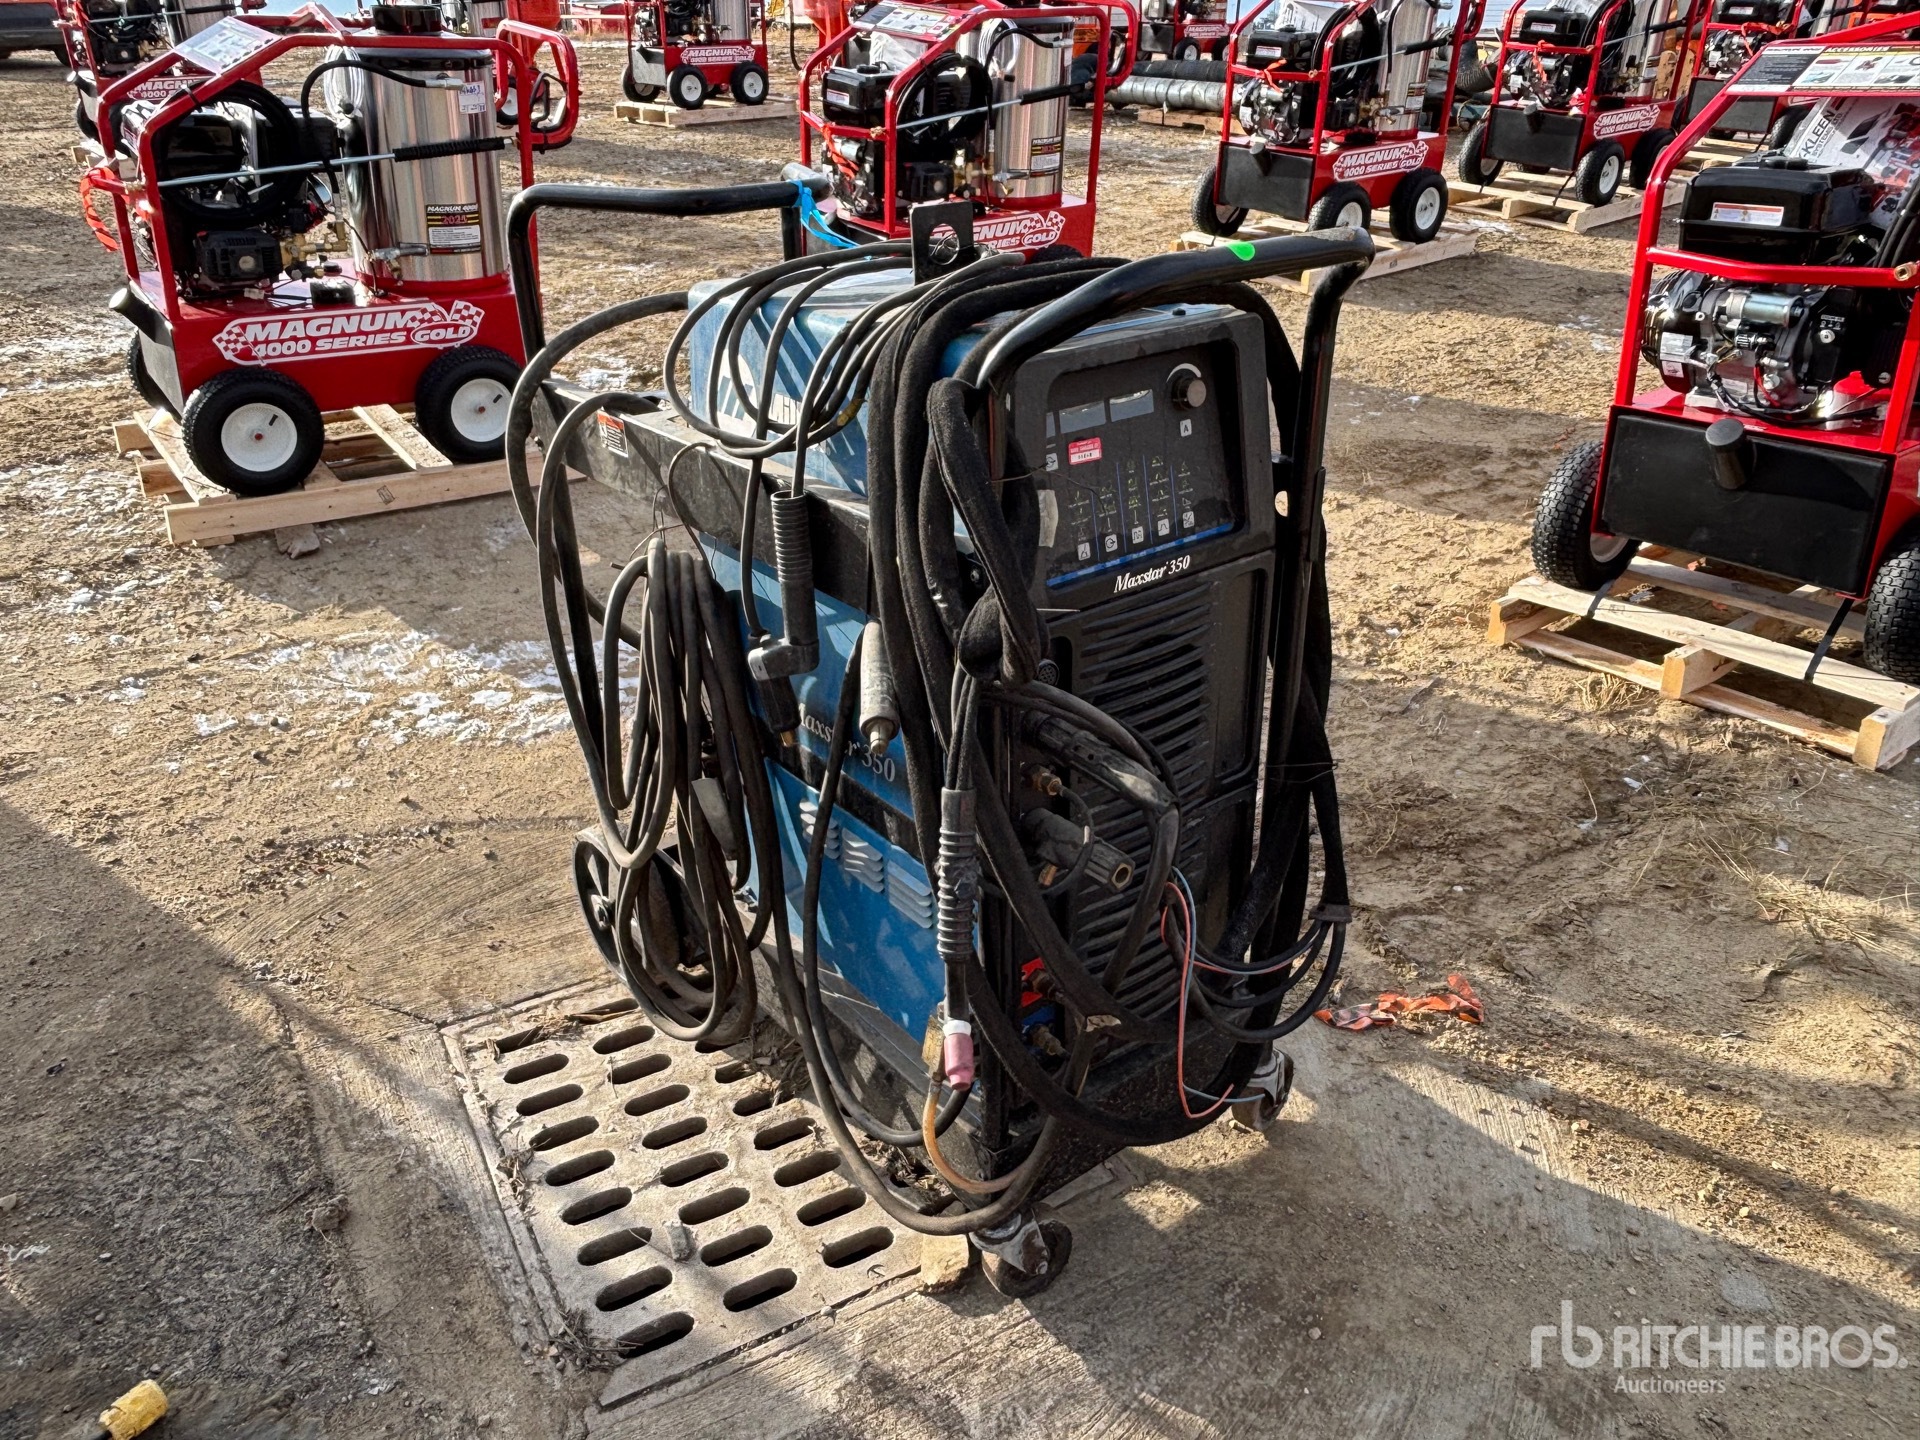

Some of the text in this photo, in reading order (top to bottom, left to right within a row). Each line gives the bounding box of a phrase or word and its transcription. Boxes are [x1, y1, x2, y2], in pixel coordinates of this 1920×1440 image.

[1601, 111, 1645, 126] MAGNUM
[1343, 147, 1406, 168] MAGNUM
[1365, 159, 1399, 174] SERIES
[1400, 156, 1422, 167] GOLD
[1023, 231, 1057, 245] GOLD
[246, 310, 412, 342] MAGNUM
[251, 326, 472, 357] 4000 SERIES GOLD
[1113, 554, 1191, 593] Maxstar 350
[860, 743, 896, 782] 350
